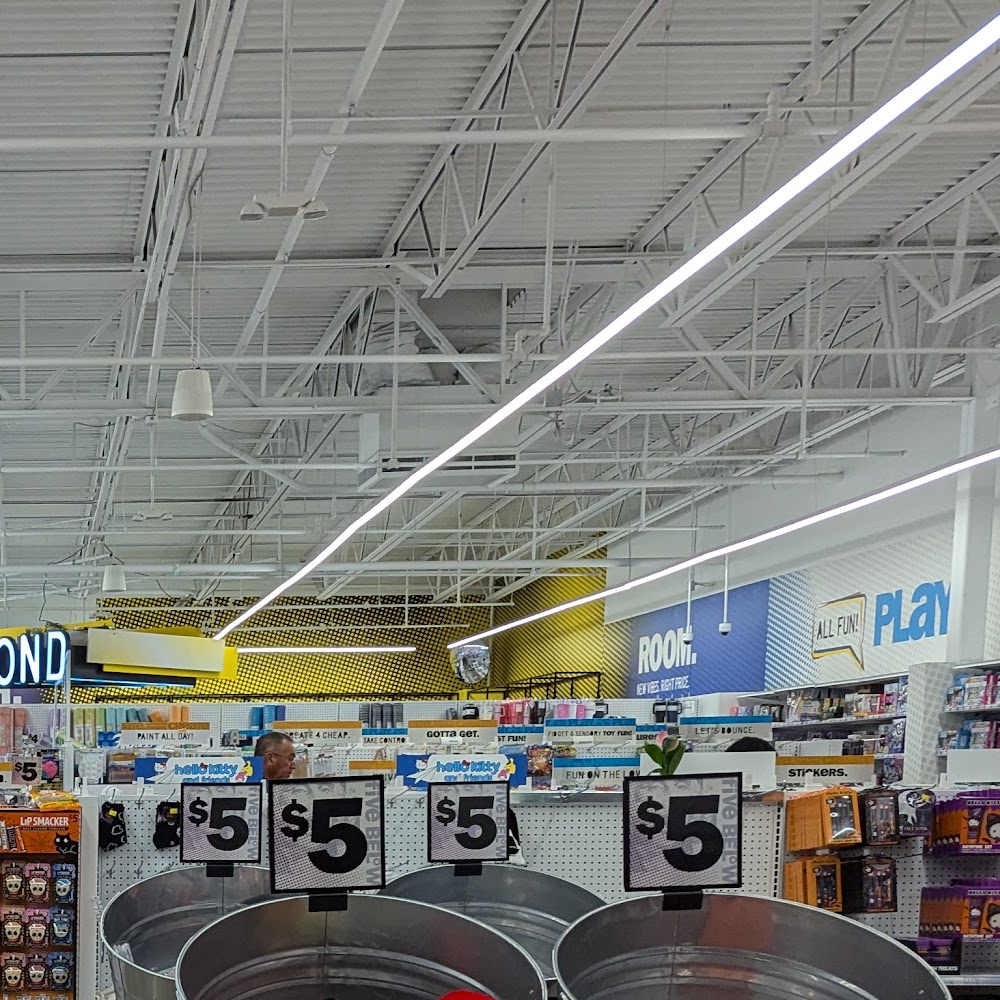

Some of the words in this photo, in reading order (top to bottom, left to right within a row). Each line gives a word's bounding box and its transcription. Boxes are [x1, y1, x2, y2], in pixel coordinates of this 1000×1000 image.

[816, 620, 834, 640] ALL
[837, 613, 859, 636] FUN!
[638, 625, 697, 674] ROOM.
[636, 682, 647, 696] NEW
[323, 731, 351, 739] CHEAP.
[695, 727, 719, 735] LET'S
[721, 726, 755, 735] BOUNCE.
[15, 762, 37, 781] $5
[175, 763, 207, 775] hello
[209, 763, 239, 776] kitty
[436, 760, 470, 772] hello
[471, 761, 501, 774] kitty
[587, 771, 600, 779] ON
[602, 770, 620, 779] THE
[33, 816, 69, 826] SMACKER
[188, 796, 250, 851] $5
[435, 796, 498, 850] $5
[280, 797, 368, 874] $5
[635, 795, 724, 872] $5
